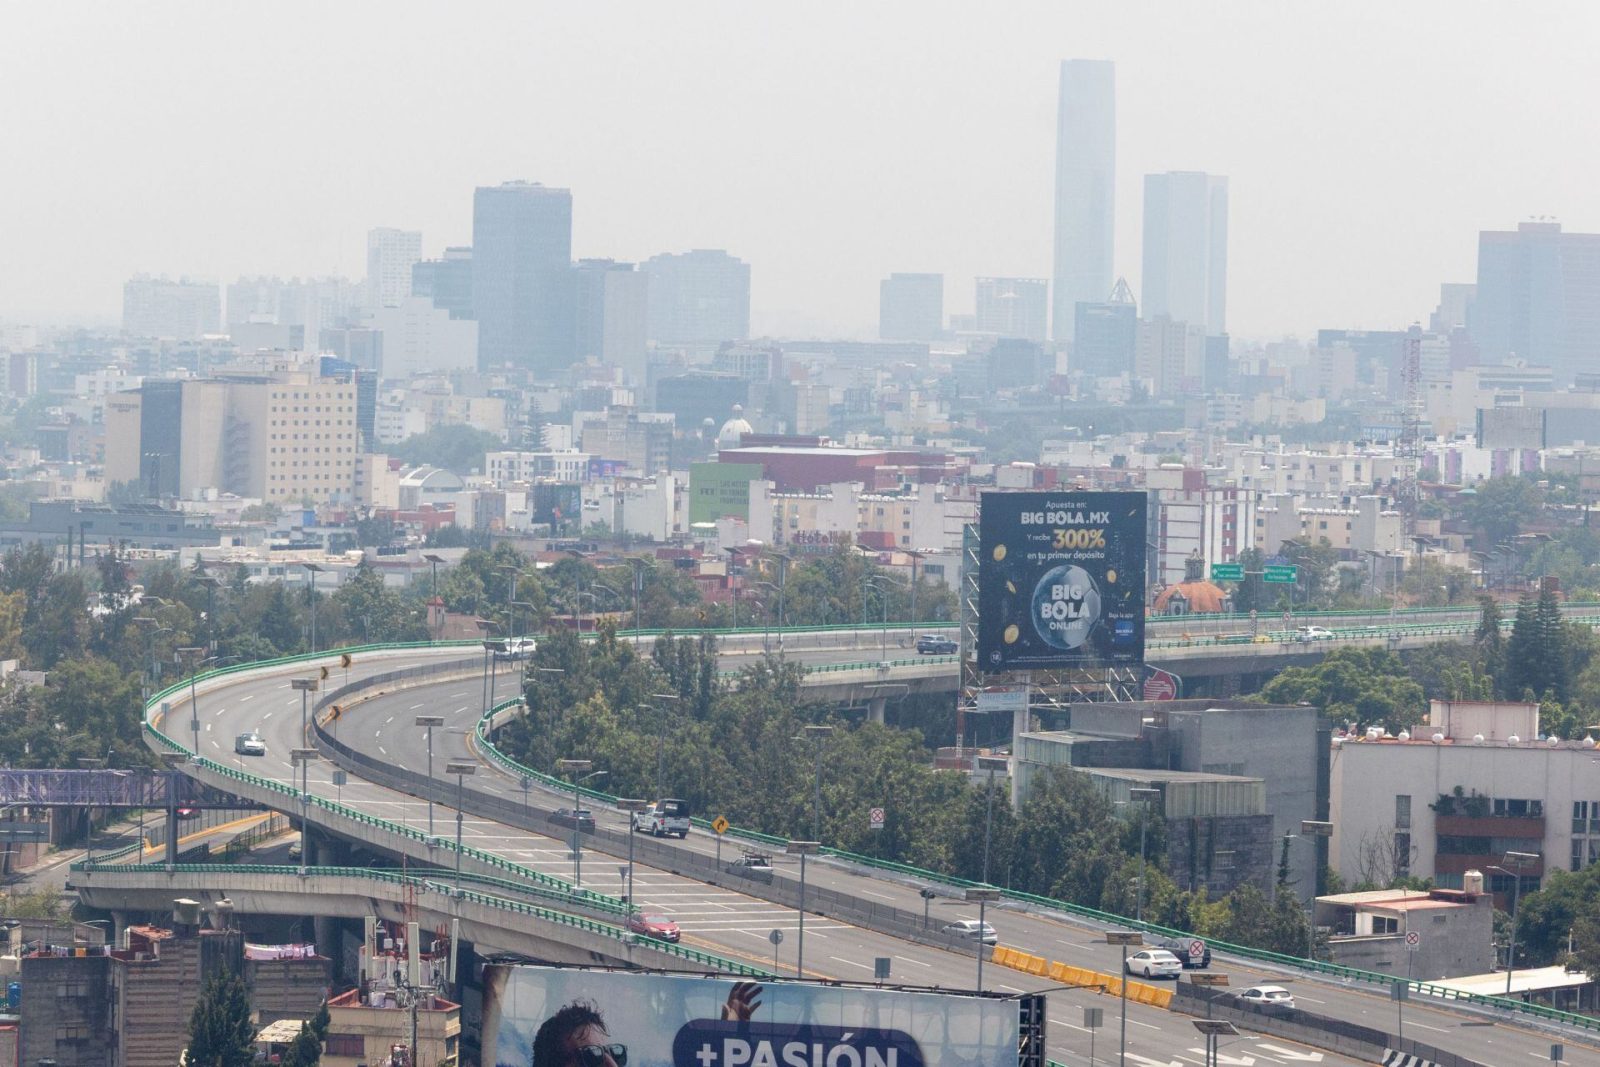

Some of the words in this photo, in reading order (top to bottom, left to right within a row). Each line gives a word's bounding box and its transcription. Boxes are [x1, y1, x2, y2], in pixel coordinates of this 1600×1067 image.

[1020, 511, 1044, 525] BIG
[1033, 533, 1051, 541] recibe
[1052, 528, 1106, 549] 300%
[1048, 551, 1072, 560] primer
[1074, 550, 1105, 560] depósito
[1052, 584, 1083, 600] BIG
[1041, 600, 1090, 620] BOLA
[1049, 621, 1083, 630] ONLINE
